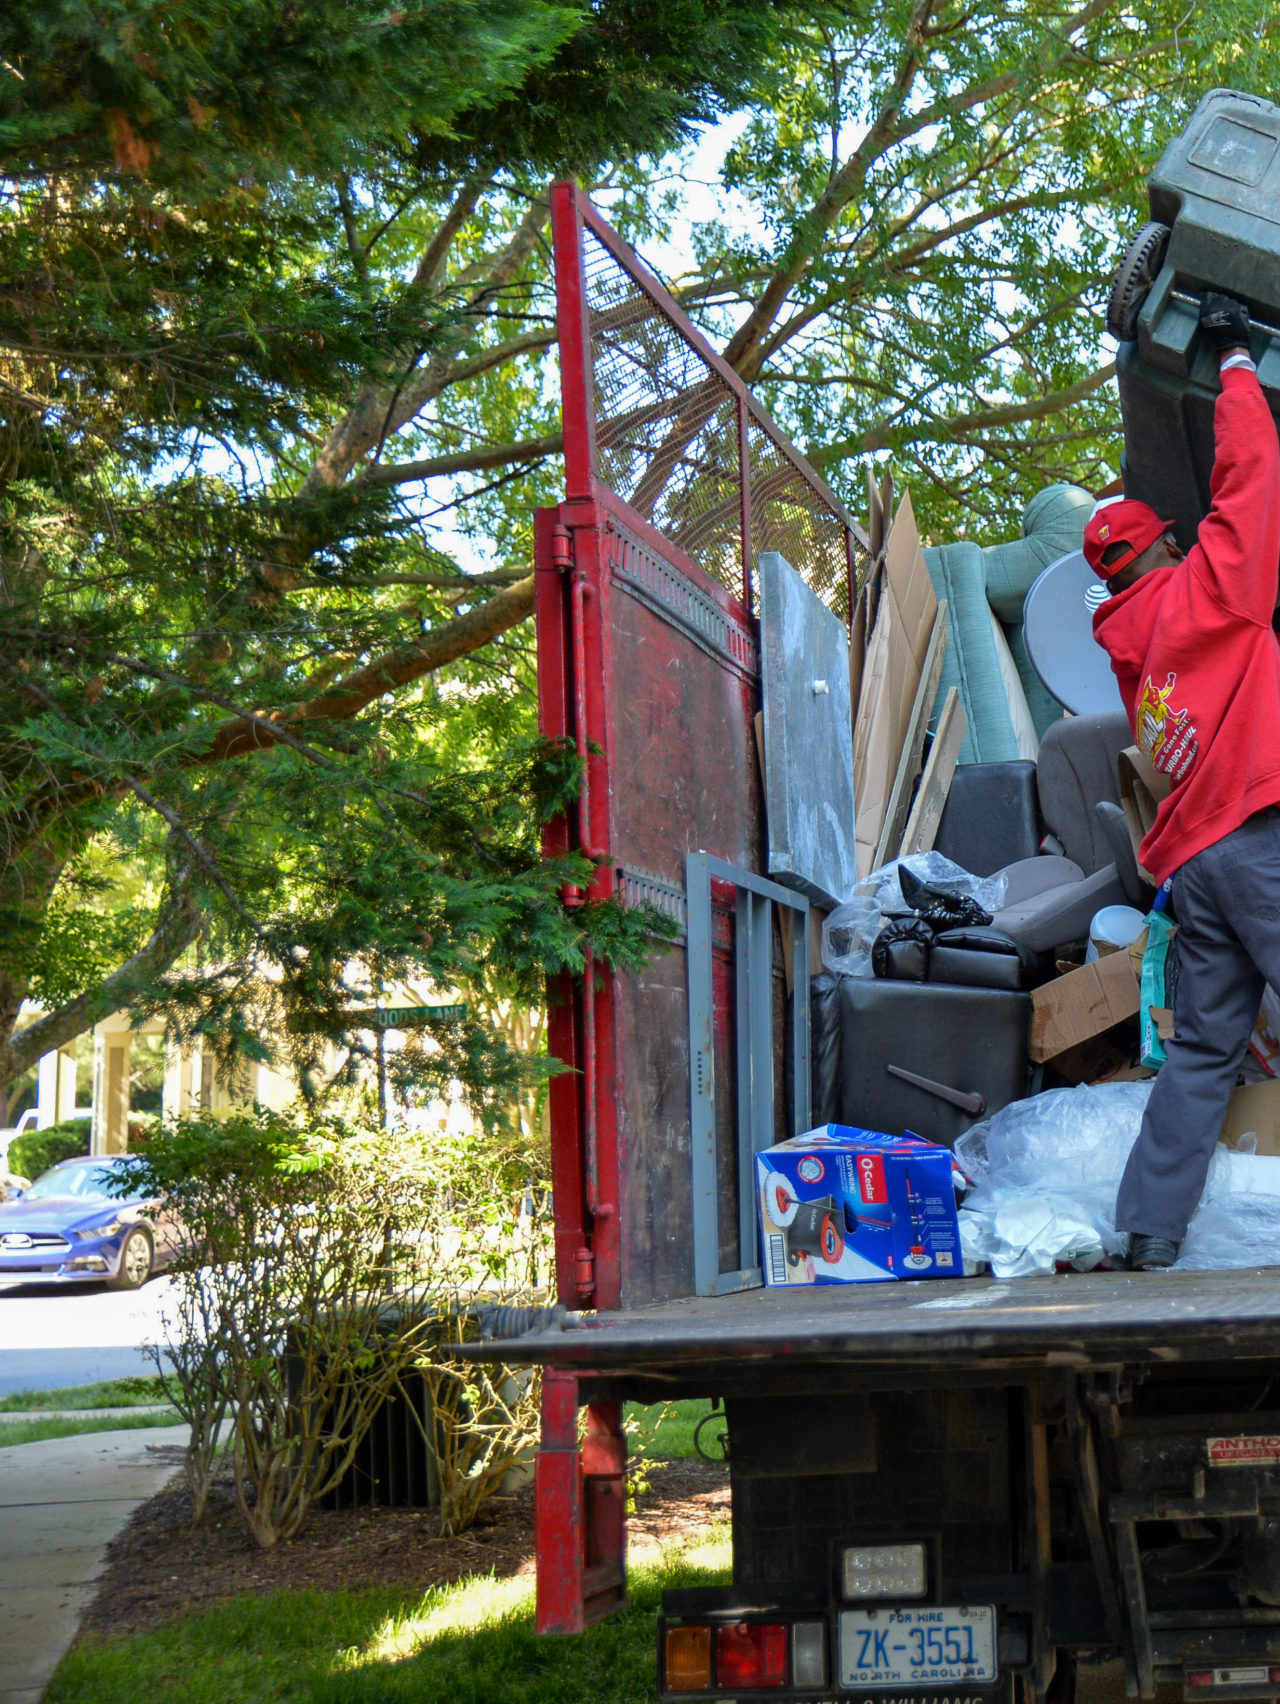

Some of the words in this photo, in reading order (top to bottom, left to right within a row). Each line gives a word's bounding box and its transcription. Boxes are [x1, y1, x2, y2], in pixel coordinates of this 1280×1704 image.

[1163, 733, 1178, 754] Gone
[1174, 717, 1191, 736] Fast.
[861, 1158, 875, 1201] O-Cedar
[889, 1614, 912, 1624] FOR
[917, 1612, 944, 1623] HIRE
[856, 1625, 979, 1669] ZK-3551
[850, 1671, 901, 1682] NORTH
[911, 1667, 986, 1679] CAROLINA
